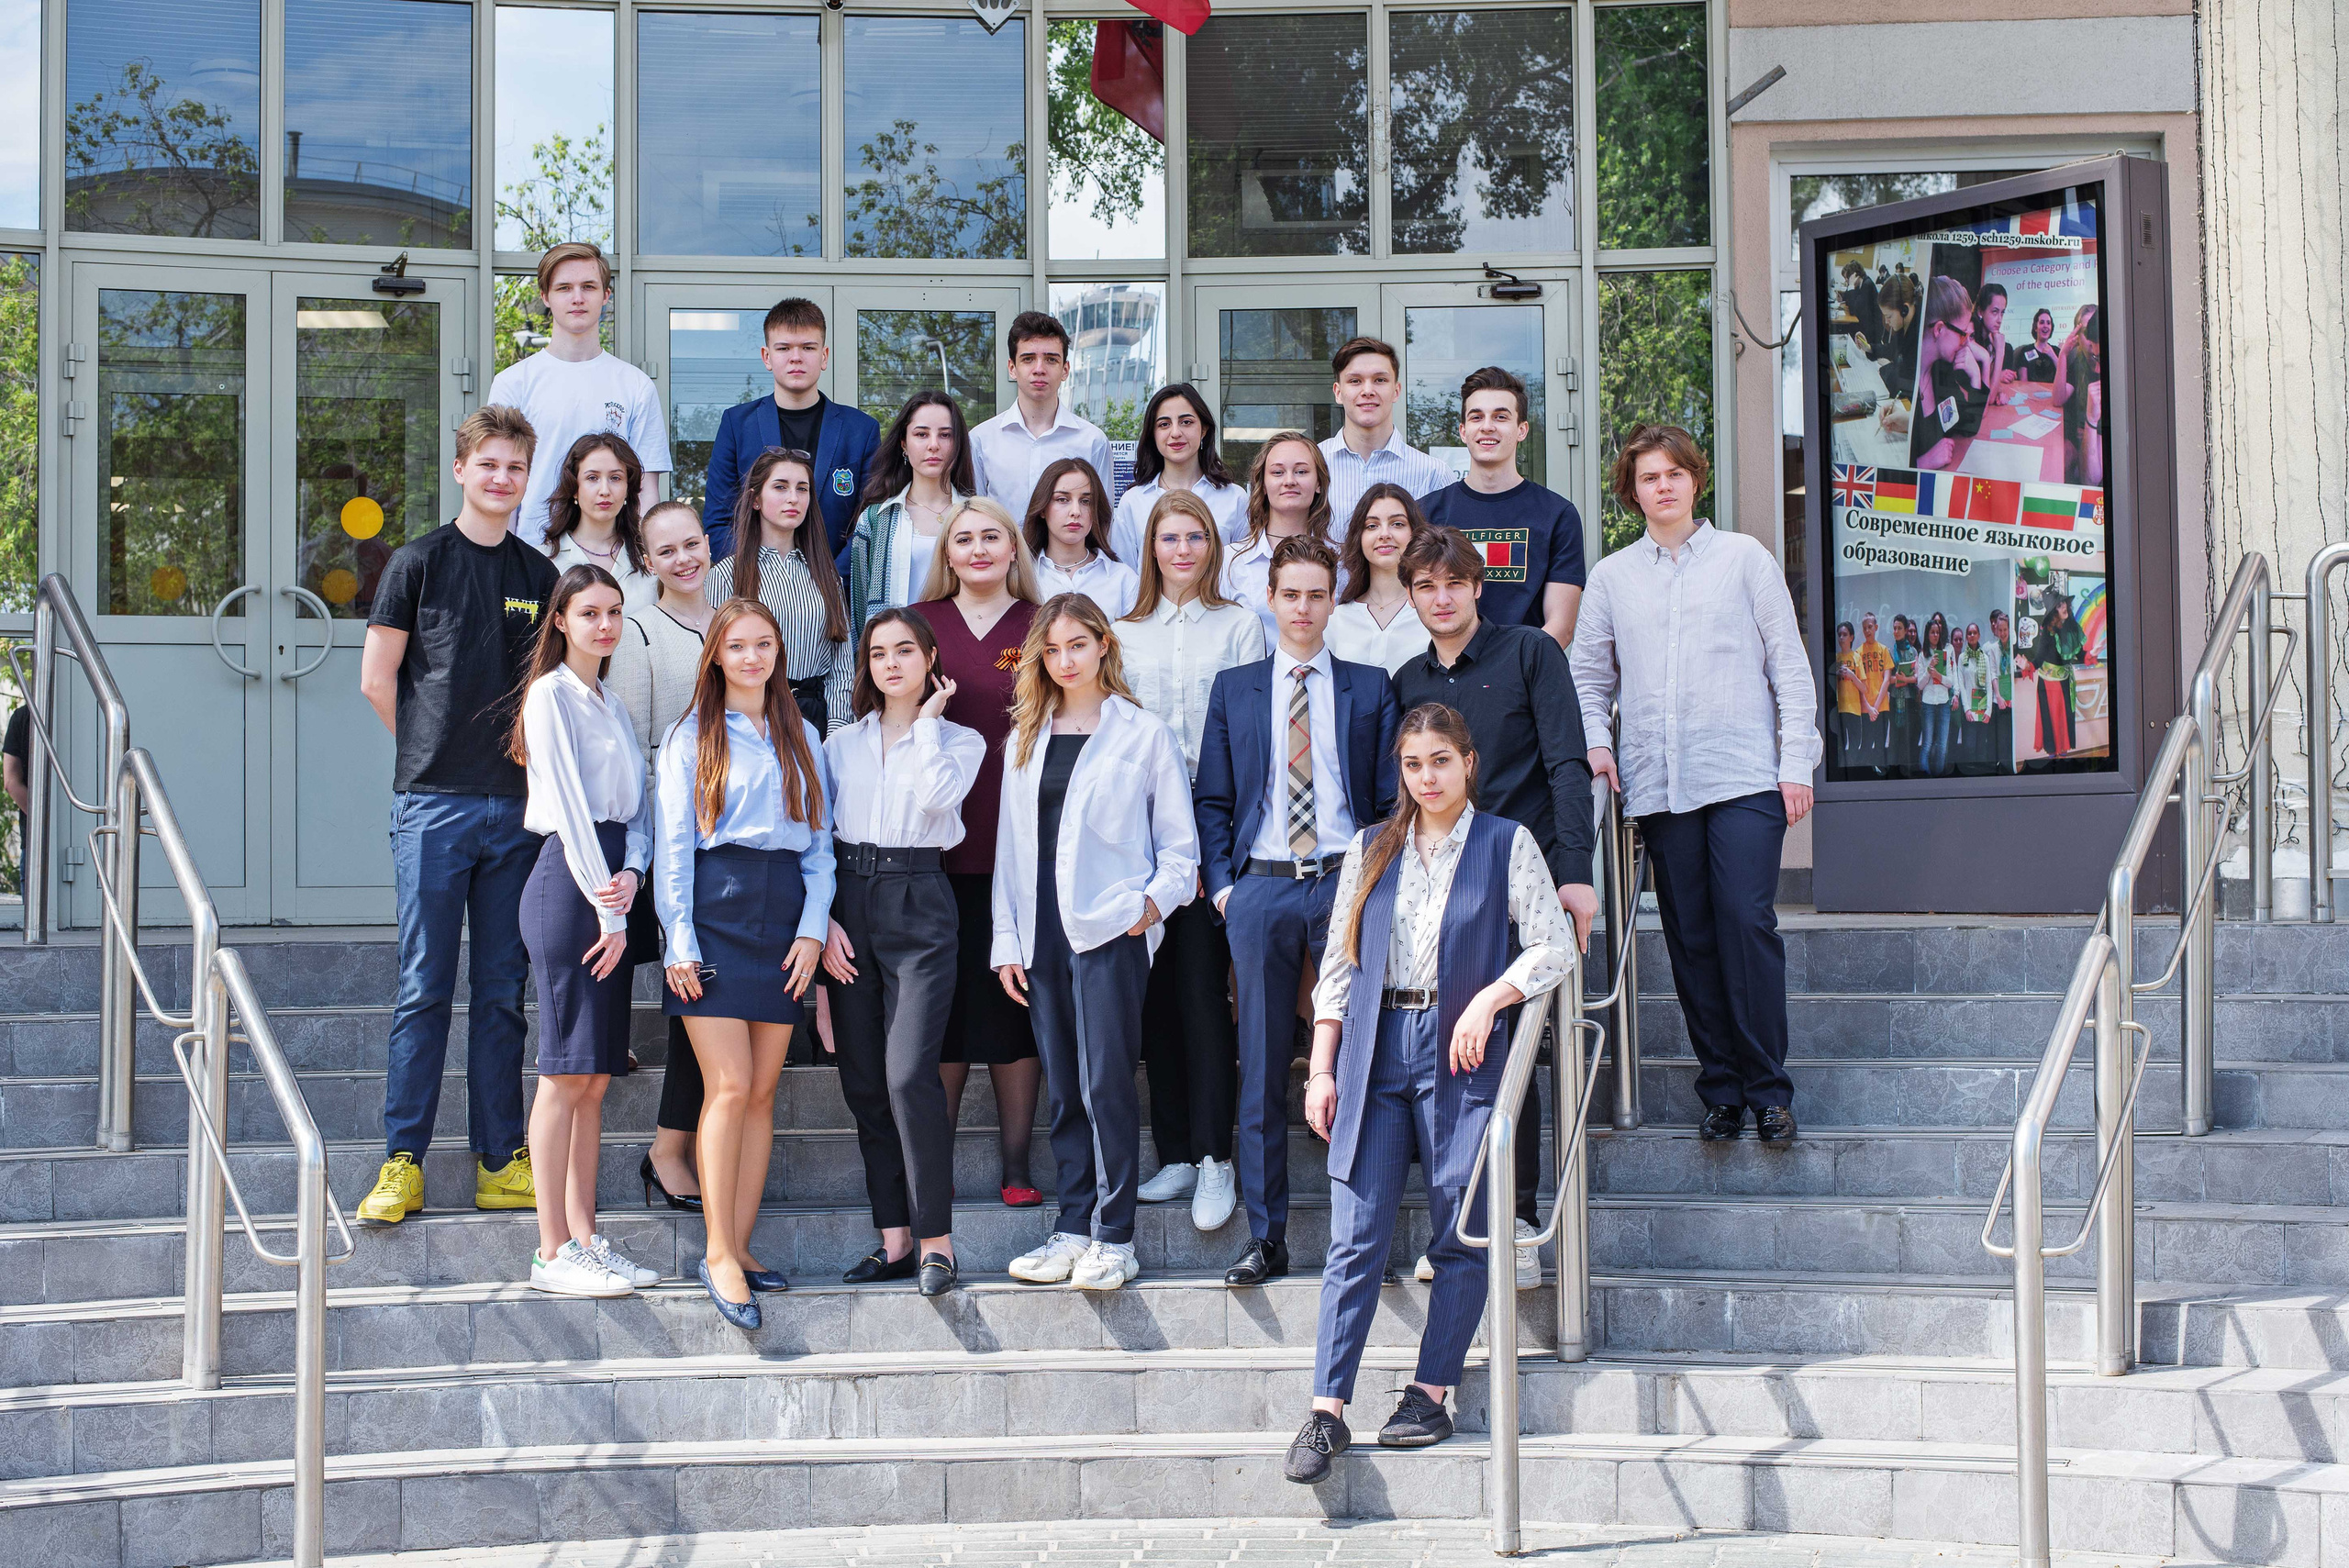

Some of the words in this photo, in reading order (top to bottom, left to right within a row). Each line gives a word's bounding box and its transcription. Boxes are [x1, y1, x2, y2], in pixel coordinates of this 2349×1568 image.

[1952, 233, 1976, 244] 1259.
[1981, 231, 2080, 247] sch1259.mskobr.ru
[1991, 266, 2021, 276] Choose
[2031, 263, 2071, 273] Category
[2073, 260, 2091, 270] and
[2016, 280, 2027, 290] of
[2028, 280, 2043, 290] the
[2044, 277, 2086, 291] question
[1465, 532, 1520, 540] ILFIGER
[1845, 509, 1979, 541] Современное
[1983, 528, 2095, 555] языковое
[1843, 541, 1969, 573] образование
[1486, 570, 1519, 578] XXXV
